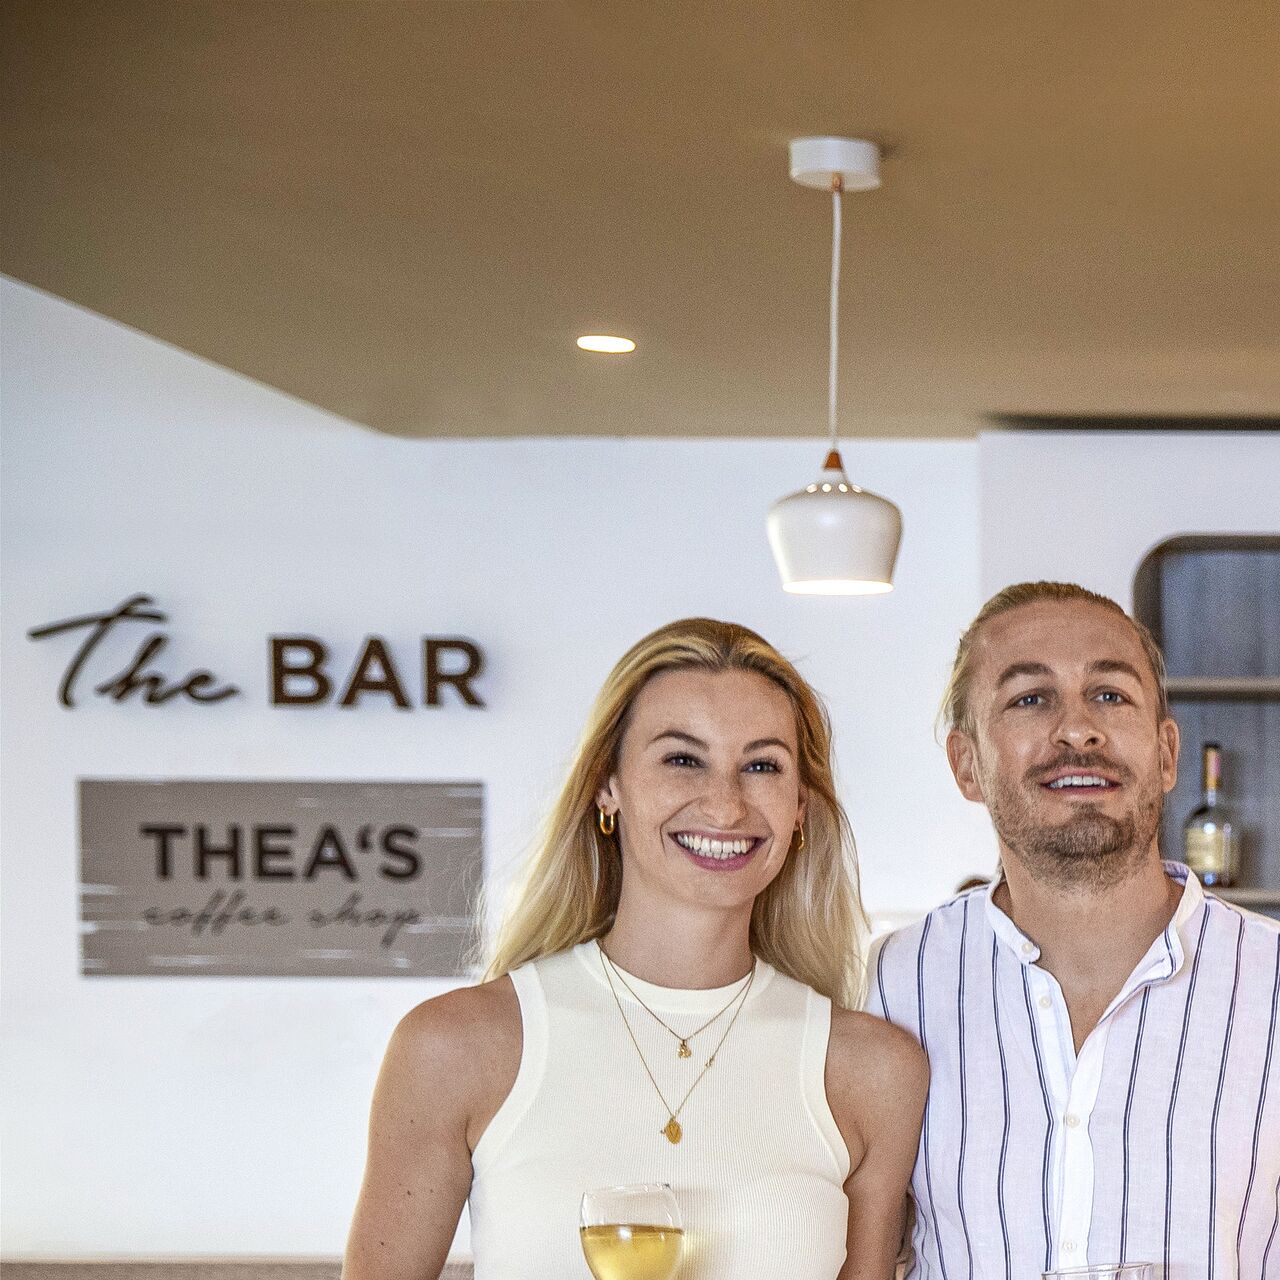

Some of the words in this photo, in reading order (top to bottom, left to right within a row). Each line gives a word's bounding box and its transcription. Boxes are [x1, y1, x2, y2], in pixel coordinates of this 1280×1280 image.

[29, 593, 241, 709] The
[267, 634, 488, 711] BAR
[139, 823, 422, 883] THEA'S
[142, 889, 287, 935] coffee
[309, 890, 420, 949] shop
